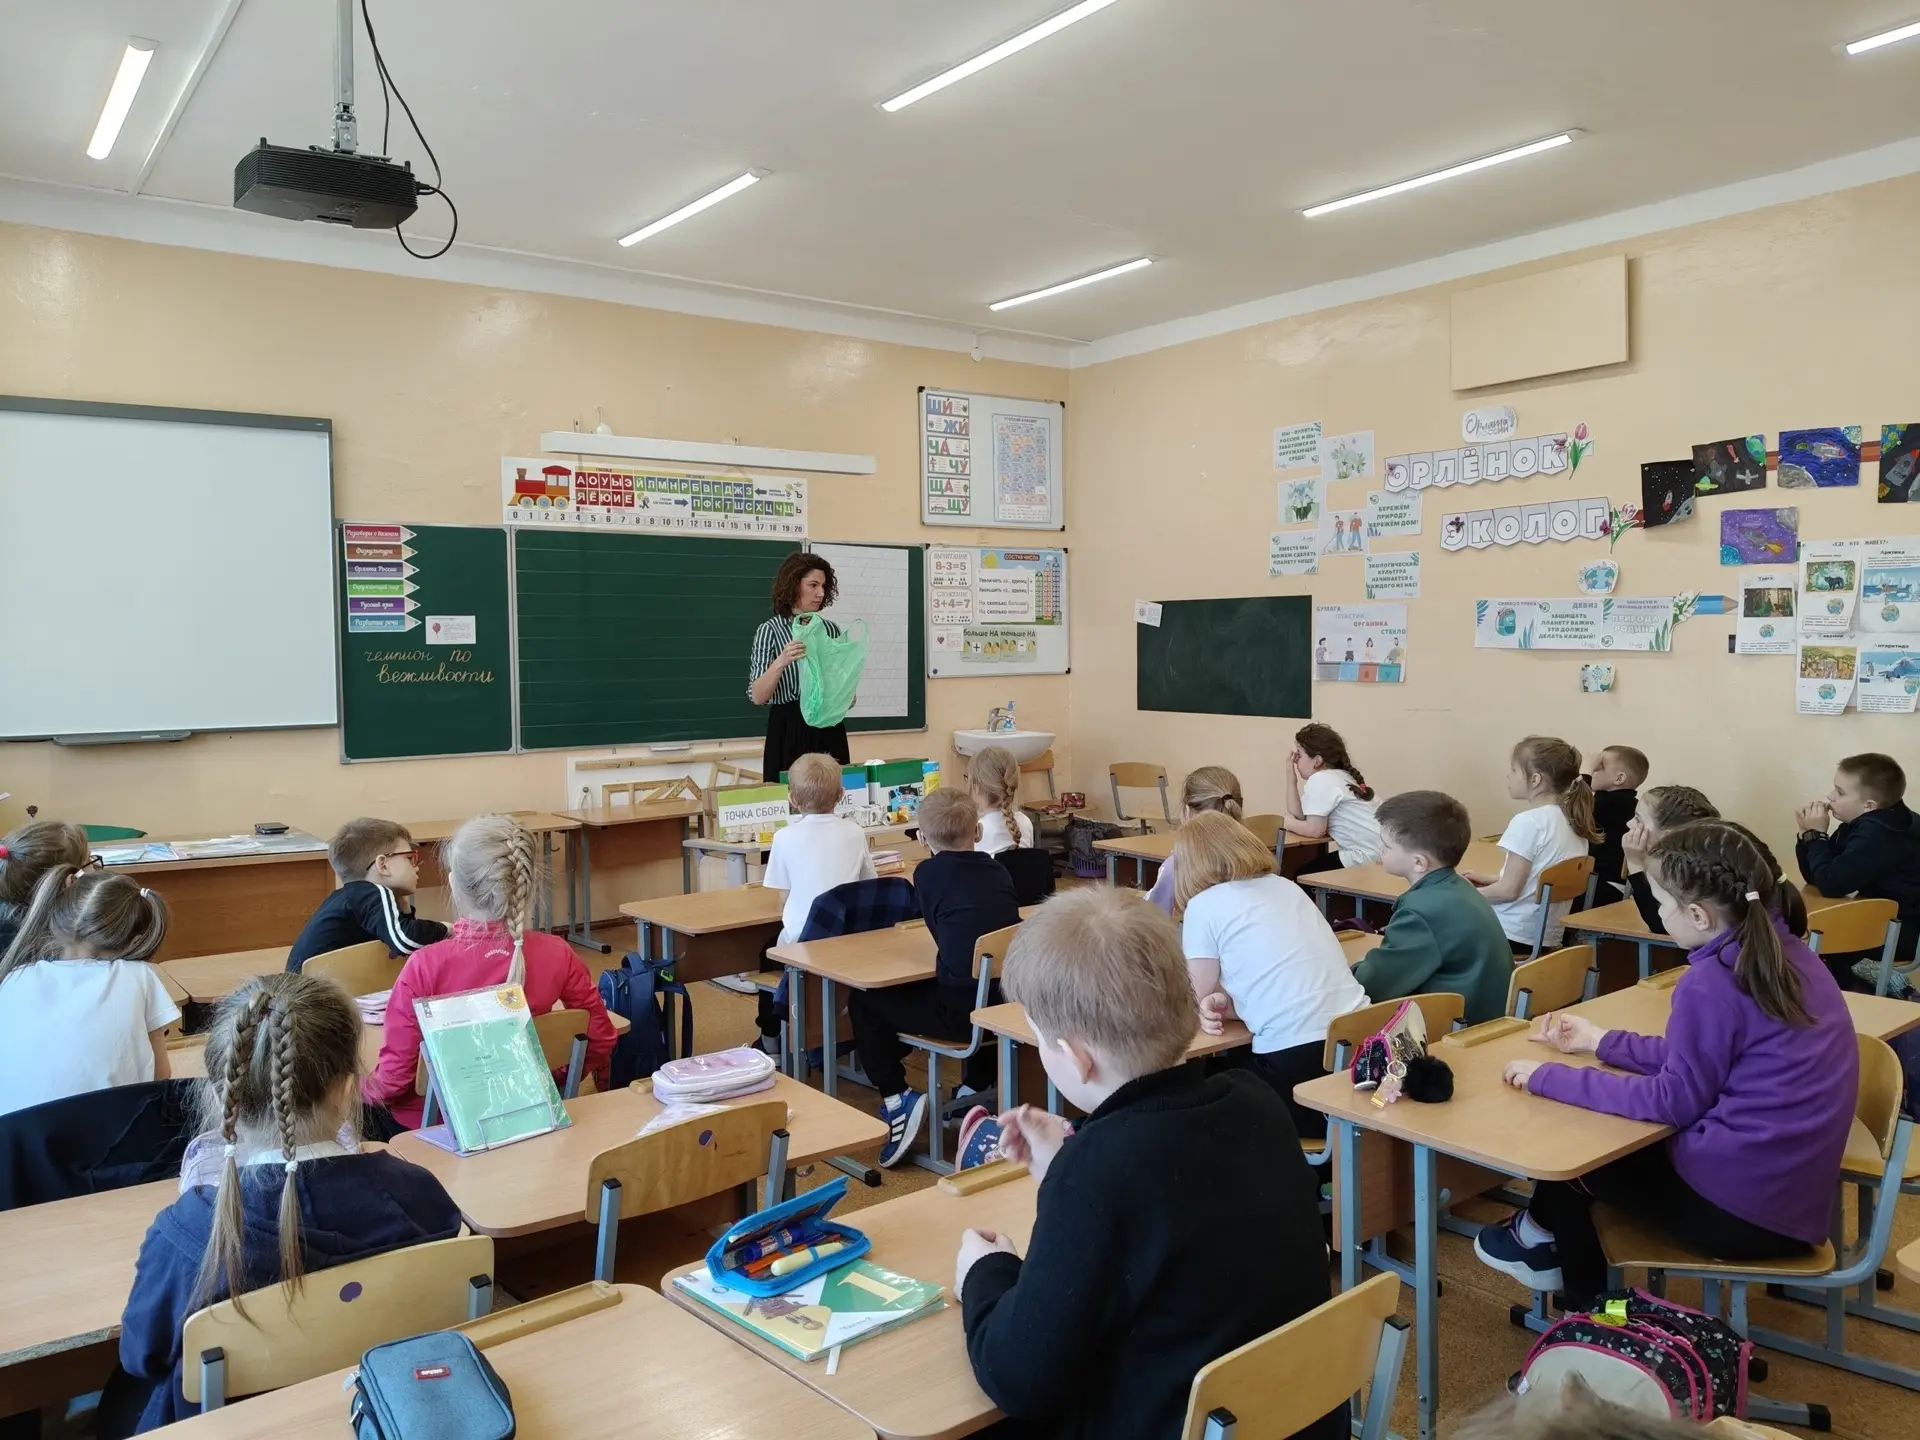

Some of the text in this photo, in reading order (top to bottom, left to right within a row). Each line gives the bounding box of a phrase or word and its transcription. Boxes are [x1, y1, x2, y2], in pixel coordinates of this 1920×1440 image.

[1386, 444, 1565, 487] ОРЛЁНОК
[576, 476, 586, 484] А
[588, 476, 598, 486] О
[601, 476, 608, 487] У
[612, 478, 622, 486] Ы
[624, 478, 632, 487] Э
[636, 477, 644, 488] Й
[648, 480, 656, 488] Л
[658, 481, 668, 490] М
[670, 482, 678, 490] Н
[681, 483, 688, 492] Р
[703, 484, 710, 492] В
[714, 485, 720, 494] Г
[724, 486, 732, 496] Д
[734, 486, 742, 494] Ж
[746, 486, 752, 496] З
[578, 492, 632, 504] Я Ё Ю И Е
[693, 498, 700, 507] П
[703, 500, 712, 508] Ф
[714, 500, 721, 508] К
[726, 501, 732, 510] Т
[734, 501, 744, 510] Ш
[746, 502, 752, 511] С
[756, 503, 762, 512] Х
[766, 504, 773, 514] Ц
[776, 504, 782, 513] Ч
[1444, 507, 1605, 546] ЭКОЛОГ
[932, 598, 970, 608] 3+4=7
[364, 650, 472, 662] чемпион по
[376, 663, 494, 684] вежливости
[724, 805, 786, 822] ТОЧКА СБОРА
